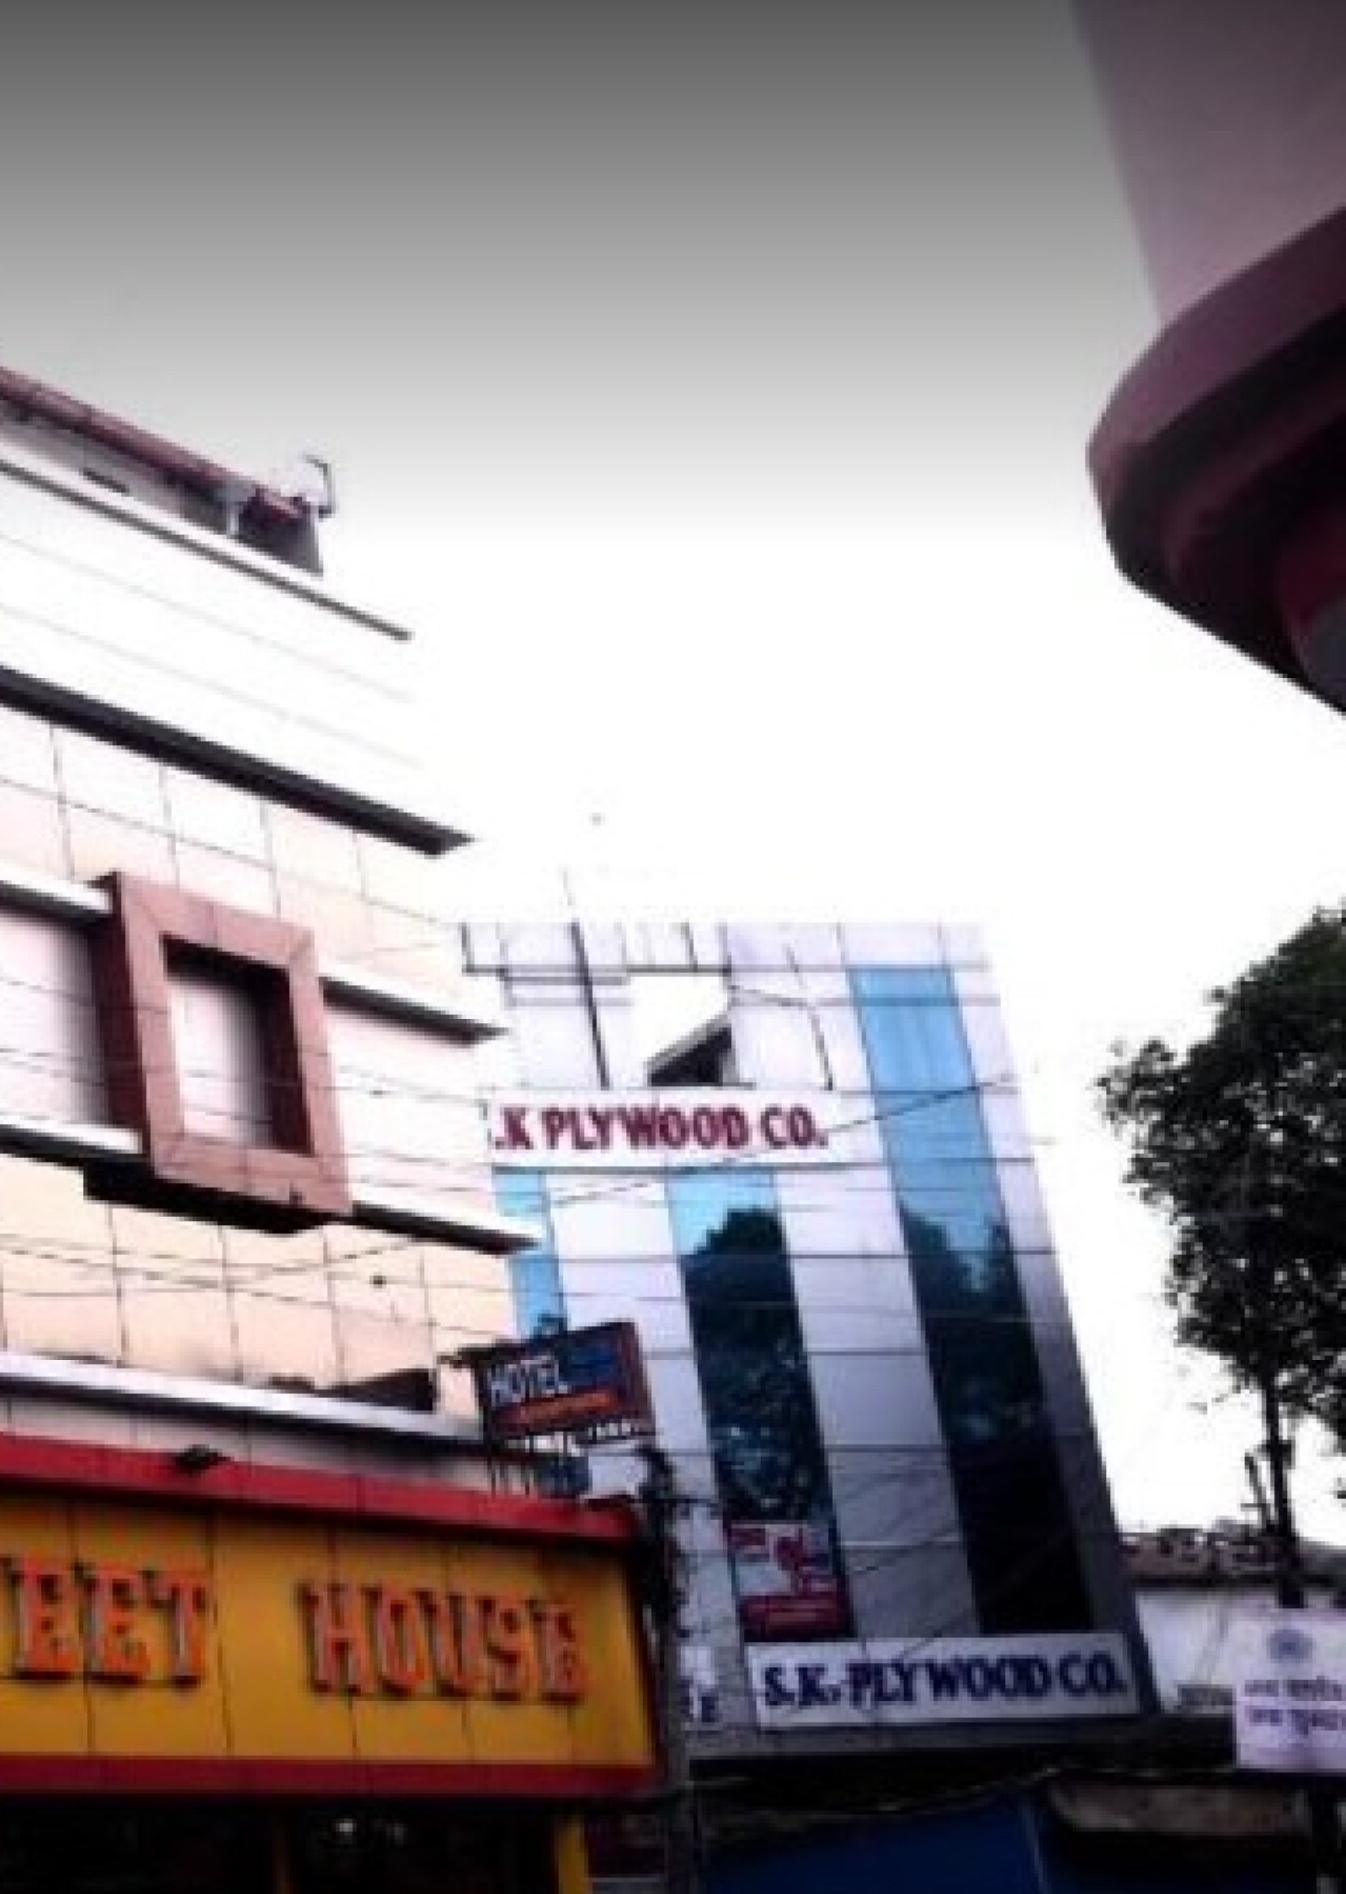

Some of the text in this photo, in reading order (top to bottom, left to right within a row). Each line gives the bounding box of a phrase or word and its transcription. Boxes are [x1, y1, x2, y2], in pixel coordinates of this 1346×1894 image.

[539, 1105, 751, 1151] PLYWOOD
[759, 1106, 830, 1151] CO.
[298, 1580, 590, 1705] HOUSE
[846, 1655, 1051, 1708] PLYWOOD
[1057, 1652, 1128, 1697] CO.
